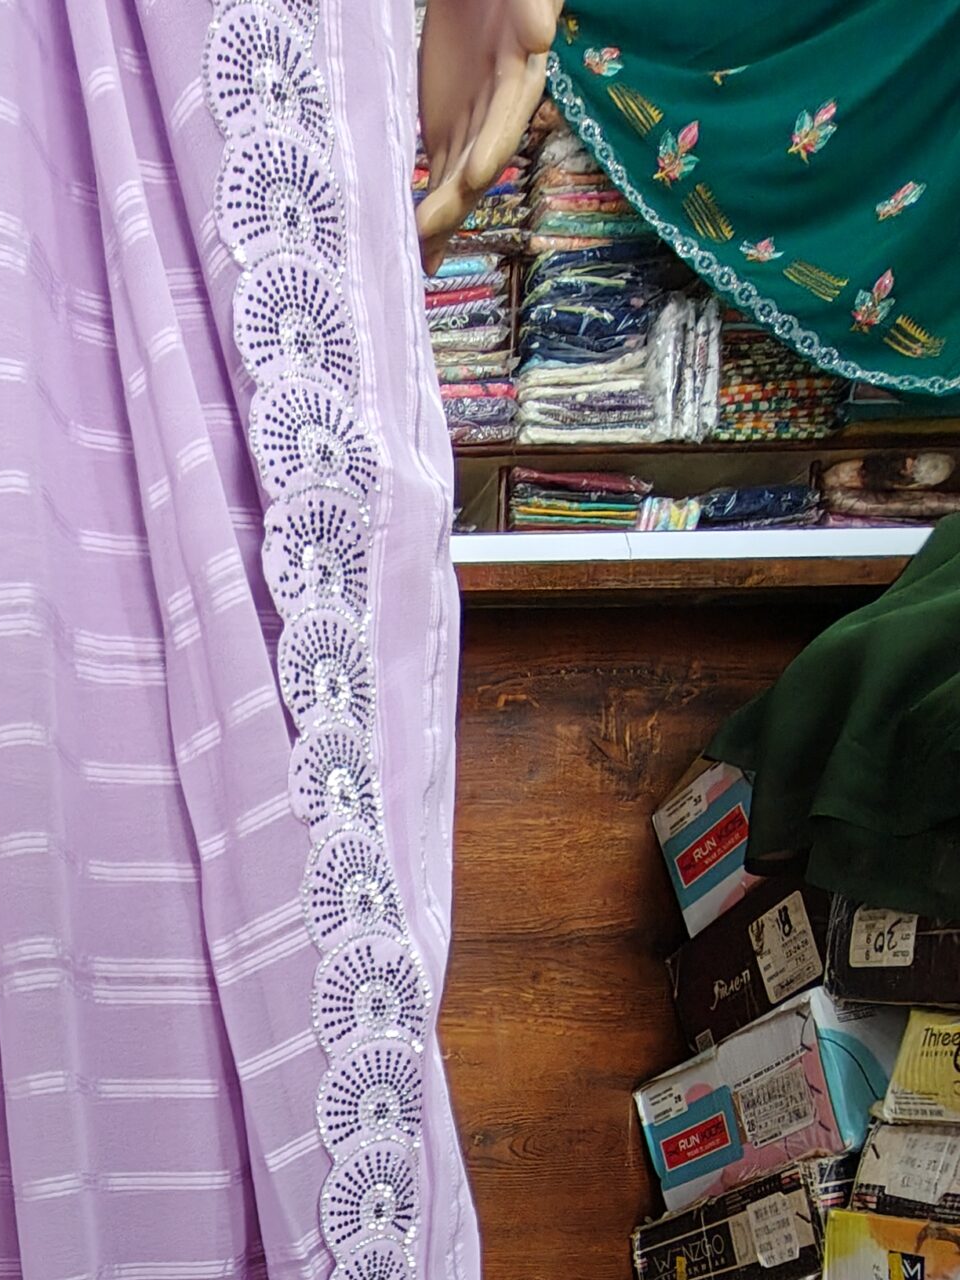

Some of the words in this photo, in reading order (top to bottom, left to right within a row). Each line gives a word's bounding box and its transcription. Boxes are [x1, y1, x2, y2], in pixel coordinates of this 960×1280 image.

[692, 836, 718, 863] RUN
[921, 1028, 960, 1047] Three
[678, 1133, 700, 1152] RUN
[652, 1234, 725, 1273] WNZGO
